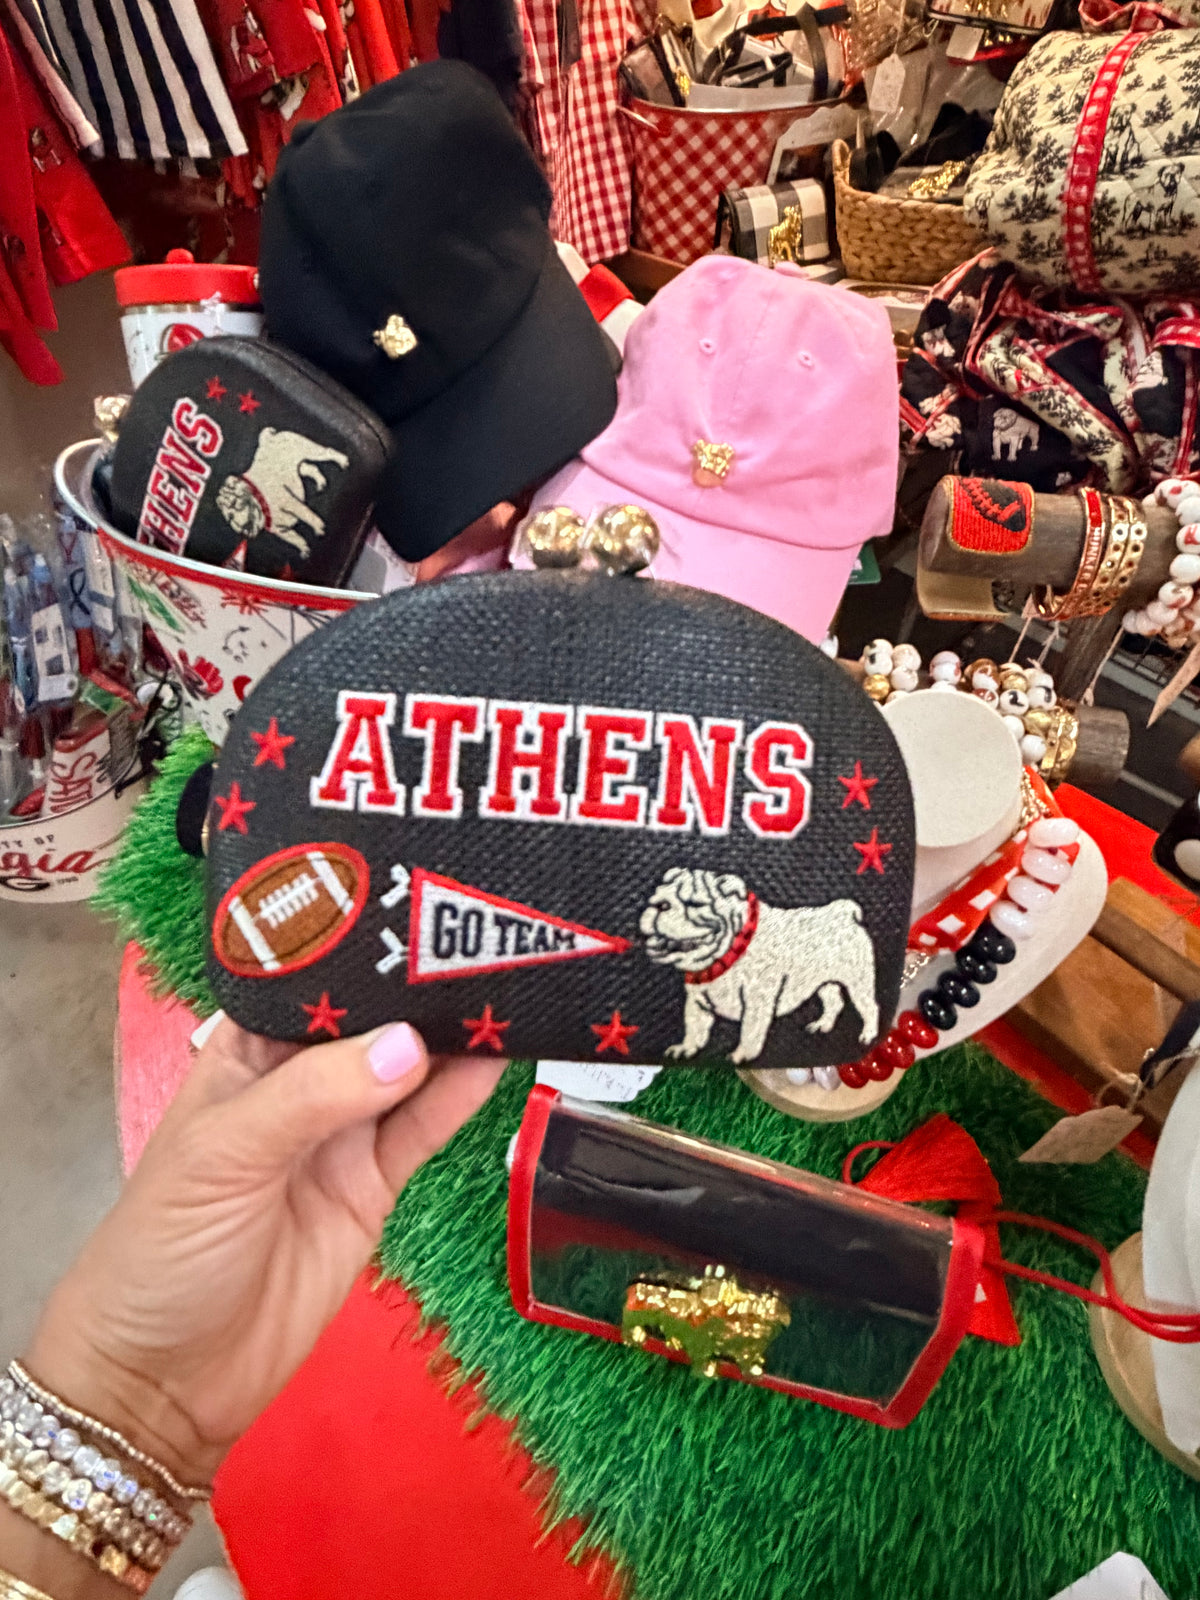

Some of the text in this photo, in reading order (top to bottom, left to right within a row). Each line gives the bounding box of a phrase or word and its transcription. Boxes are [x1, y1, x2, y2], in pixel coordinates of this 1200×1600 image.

[137, 397, 223, 556] HENS
[310, 690, 814, 838] ATHENS
[433, 902, 576, 959] GO TEAM
